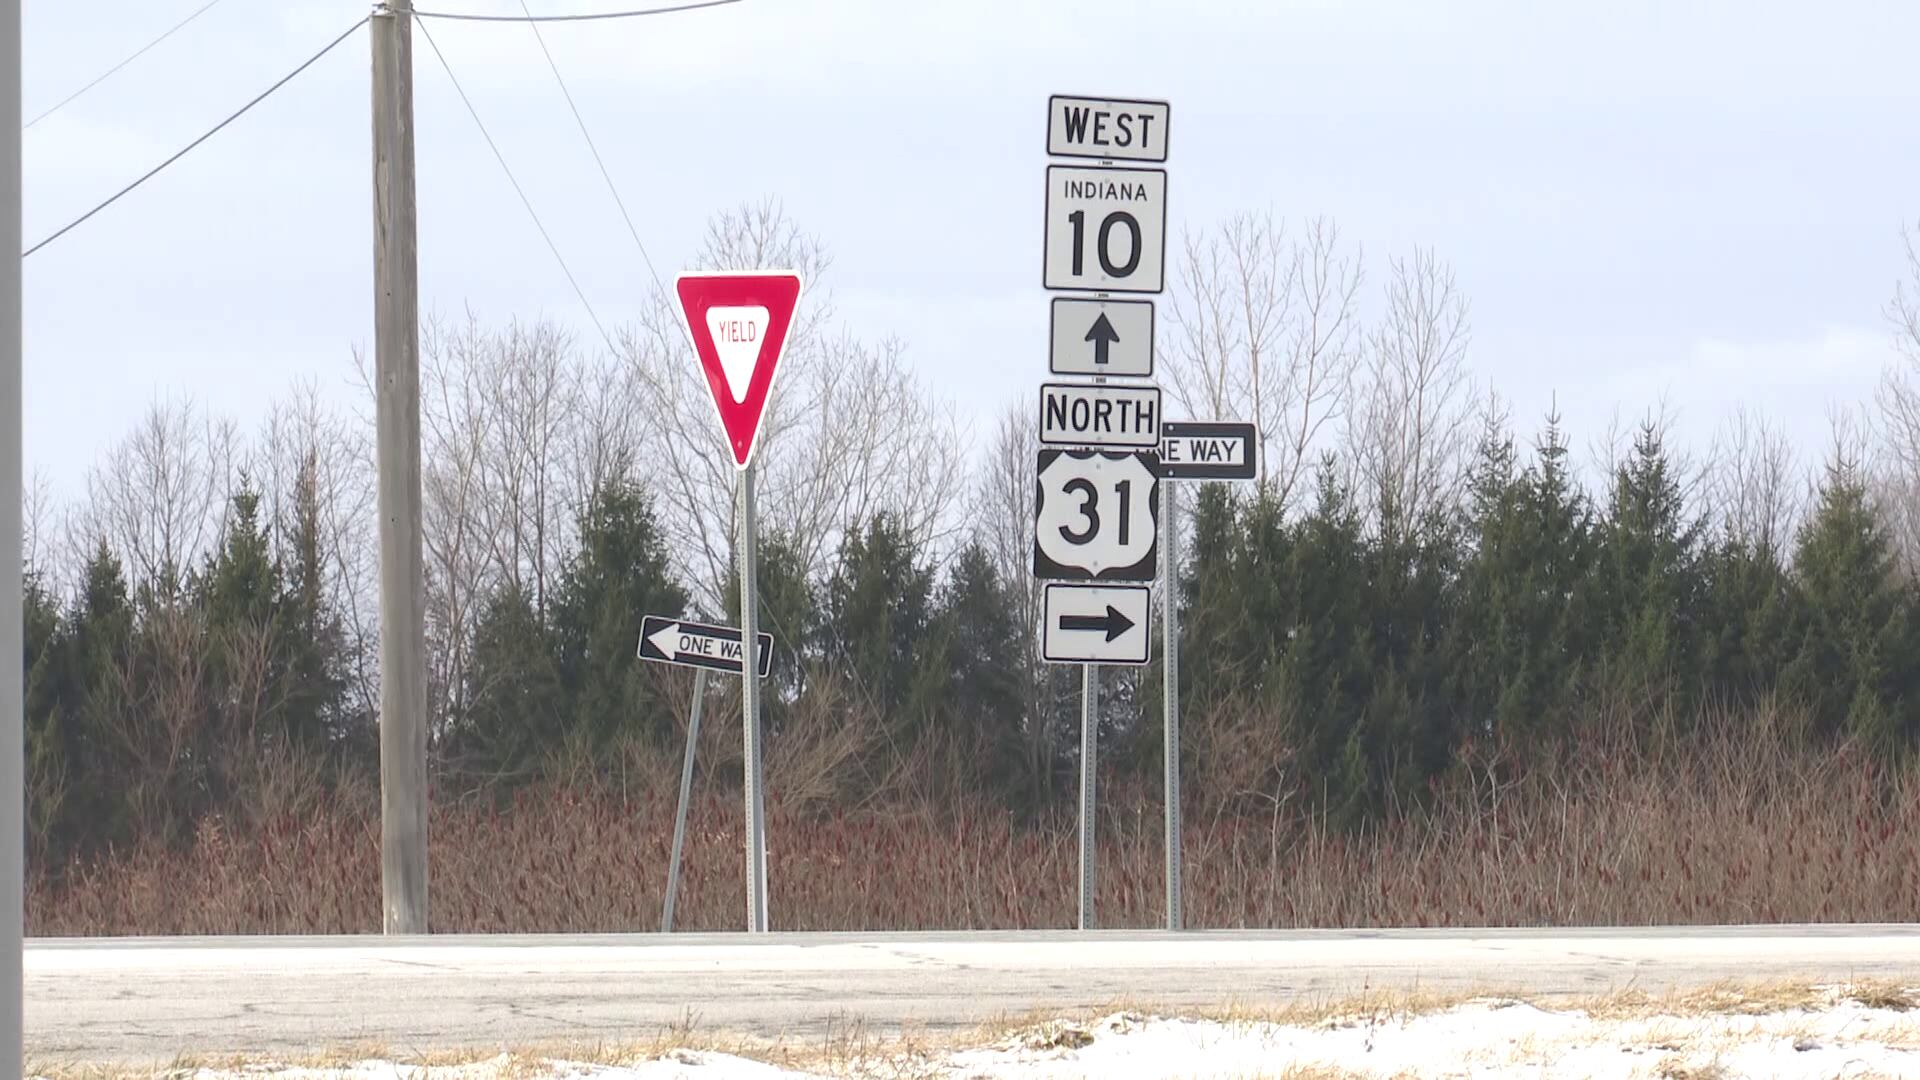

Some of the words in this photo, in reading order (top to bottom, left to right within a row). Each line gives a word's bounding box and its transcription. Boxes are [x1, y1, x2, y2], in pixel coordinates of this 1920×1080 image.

[1064, 106, 1154, 148] WEST
[1065, 180, 1147, 201] INDIANA
[1068, 210, 1142, 278] 10
[719, 320, 756, 342] YIELD
[1047, 394, 1153, 434] NORTH
[1147, 439, 1180, 461] NE
[1190, 439, 1237, 462] WAY
[1058, 477, 1131, 546] 31
[680, 635, 714, 655] ONE
[720, 640, 743, 658] WA
